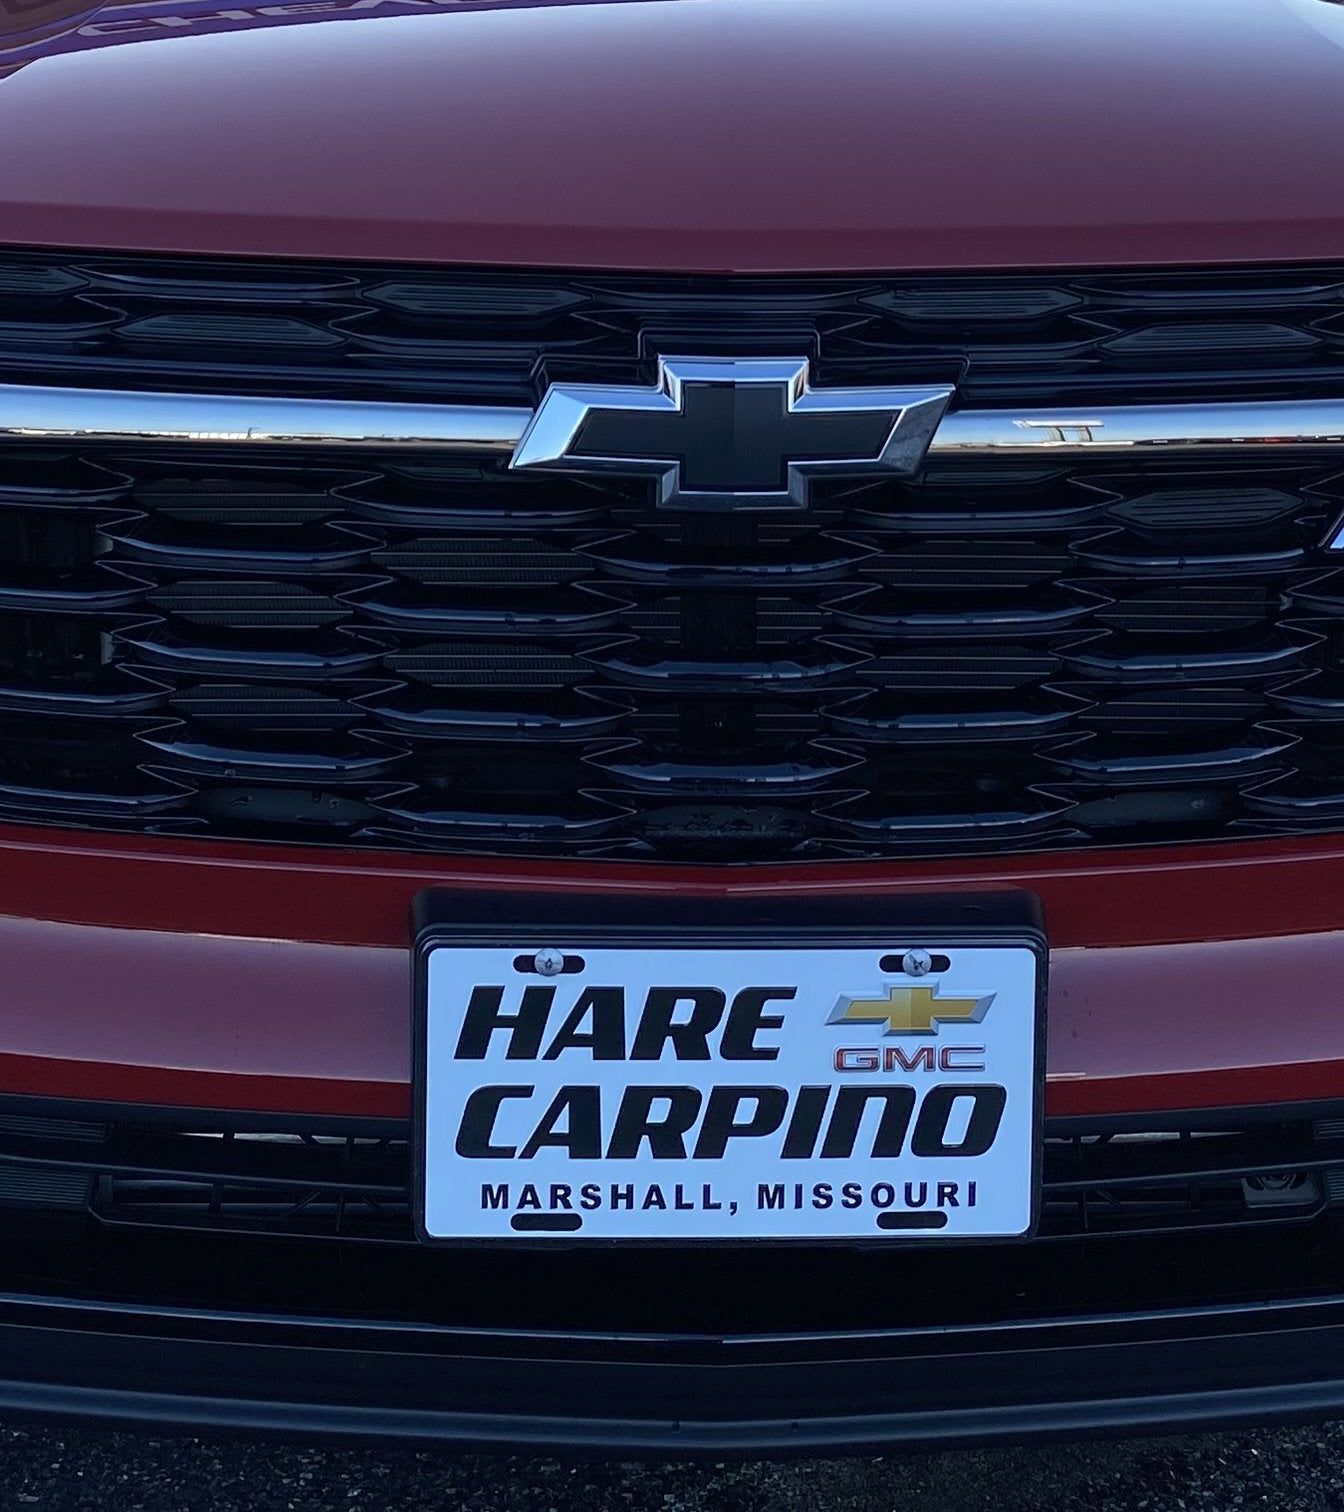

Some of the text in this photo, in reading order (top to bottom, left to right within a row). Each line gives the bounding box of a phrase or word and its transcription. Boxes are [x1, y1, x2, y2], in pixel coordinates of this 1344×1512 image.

[453, 986, 798, 1061] HARE
[833, 1044, 987, 1073] GMC
[454, 1083, 1008, 1160] CARPINO
[481, 1181, 979, 1217] MARSHALL, MISSOURI
